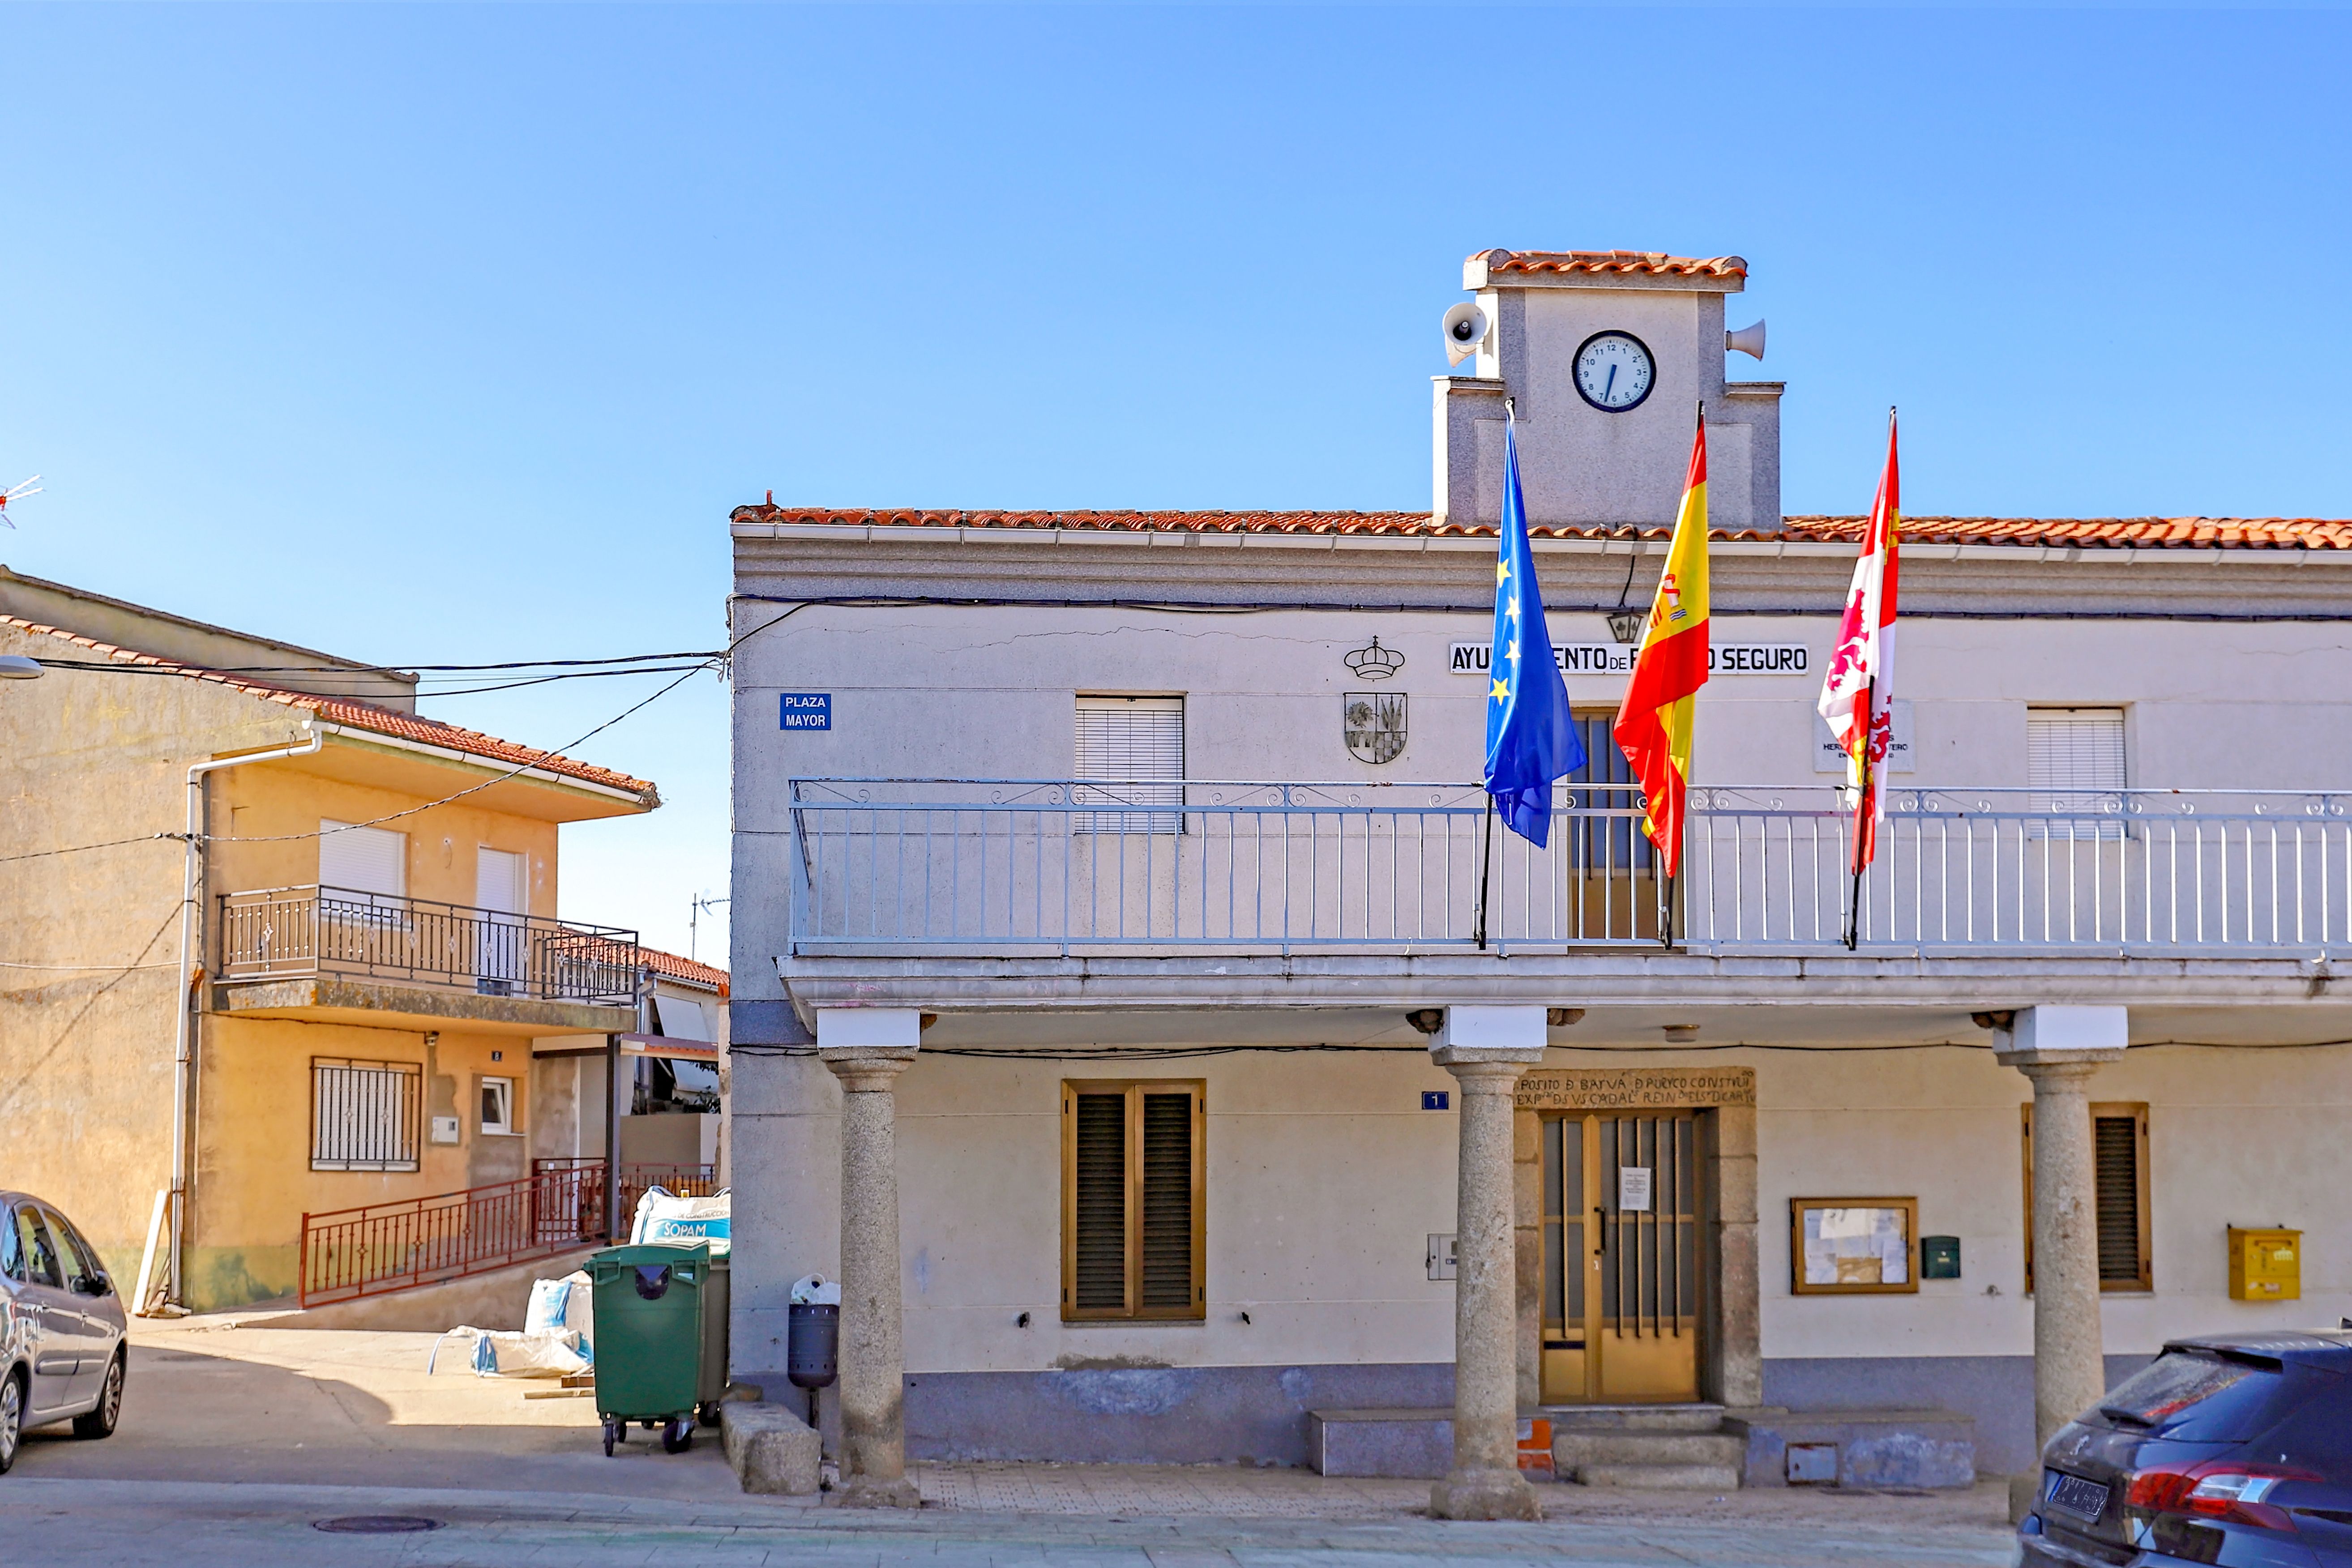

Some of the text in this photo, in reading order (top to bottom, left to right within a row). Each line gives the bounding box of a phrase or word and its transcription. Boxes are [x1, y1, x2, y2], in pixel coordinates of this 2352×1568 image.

[1452, 647, 1607, 670] AYUENTO
[1610, 657, 1626, 670] DE
[1722, 648, 1807, 670] SEGURO
[786, 697, 825, 707] PLAZA
[786, 714, 825, 726] MAYOR
[1432, 1094, 1438, 1106] 1
[664, 1222, 707, 1237] SOPAM
